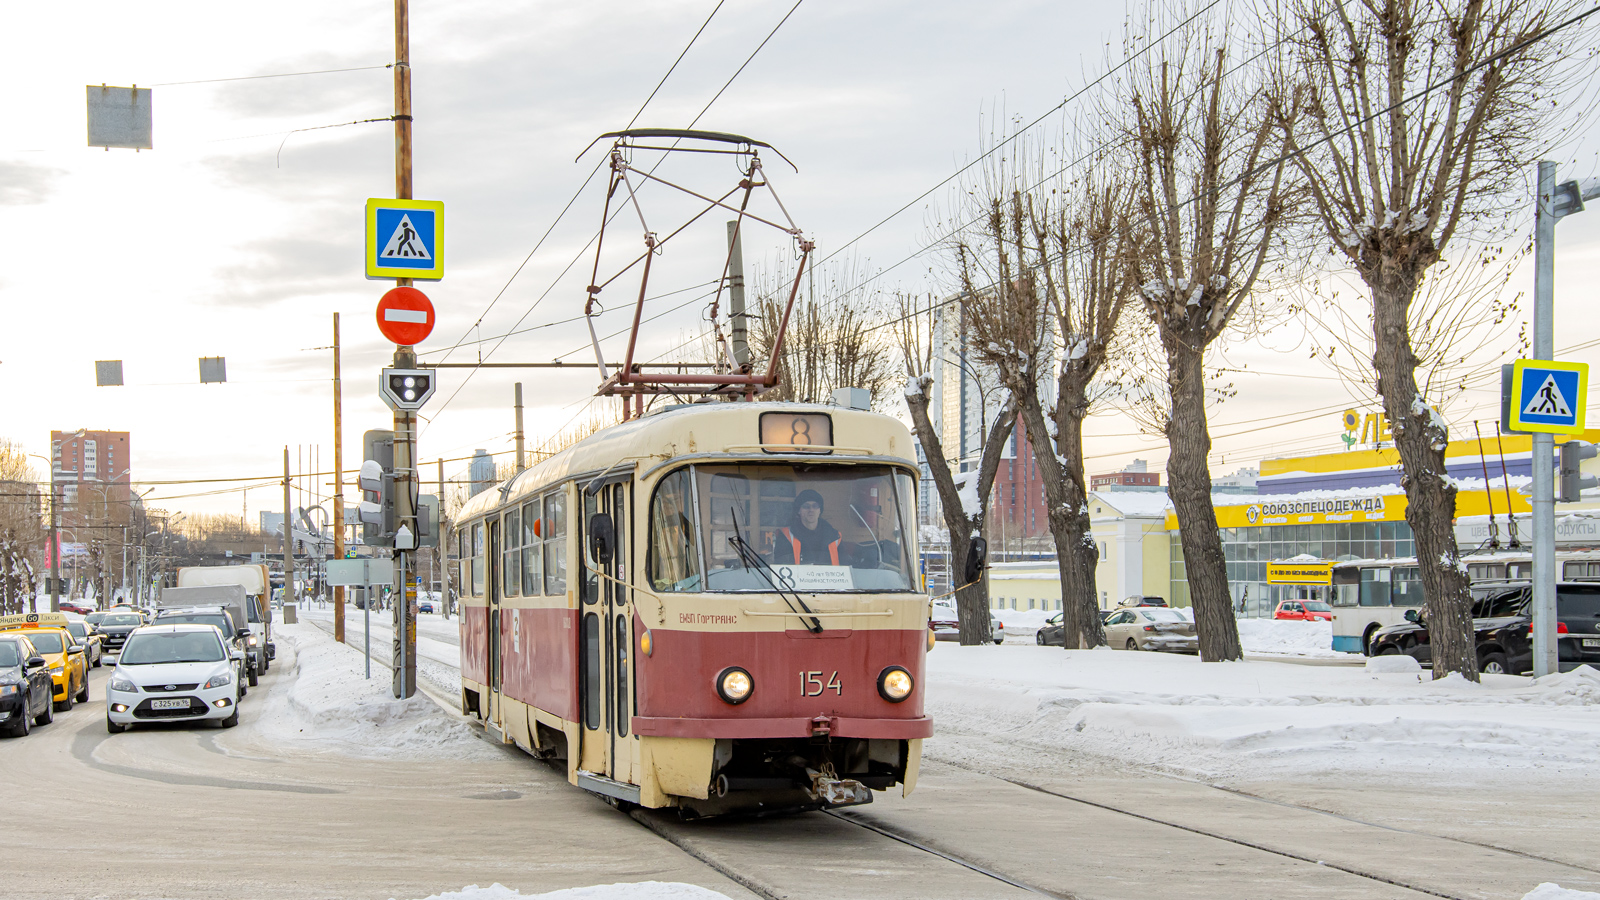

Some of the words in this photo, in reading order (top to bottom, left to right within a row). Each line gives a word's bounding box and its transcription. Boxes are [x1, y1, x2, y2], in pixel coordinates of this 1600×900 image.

[790, 418, 812, 451] 8
[1360, 412, 1392, 444] ЛЕ
[1262, 497, 1383, 515] СОЮЗСПЕЦОДЕЖДА
[1555, 523, 1597, 537] ОДУКТЫ
[779, 566, 796, 590] 8
[27, 614, 38, 622] Go
[697, 613, 737, 624] ГОРТРАНС
[799, 670, 843, 697] 154
